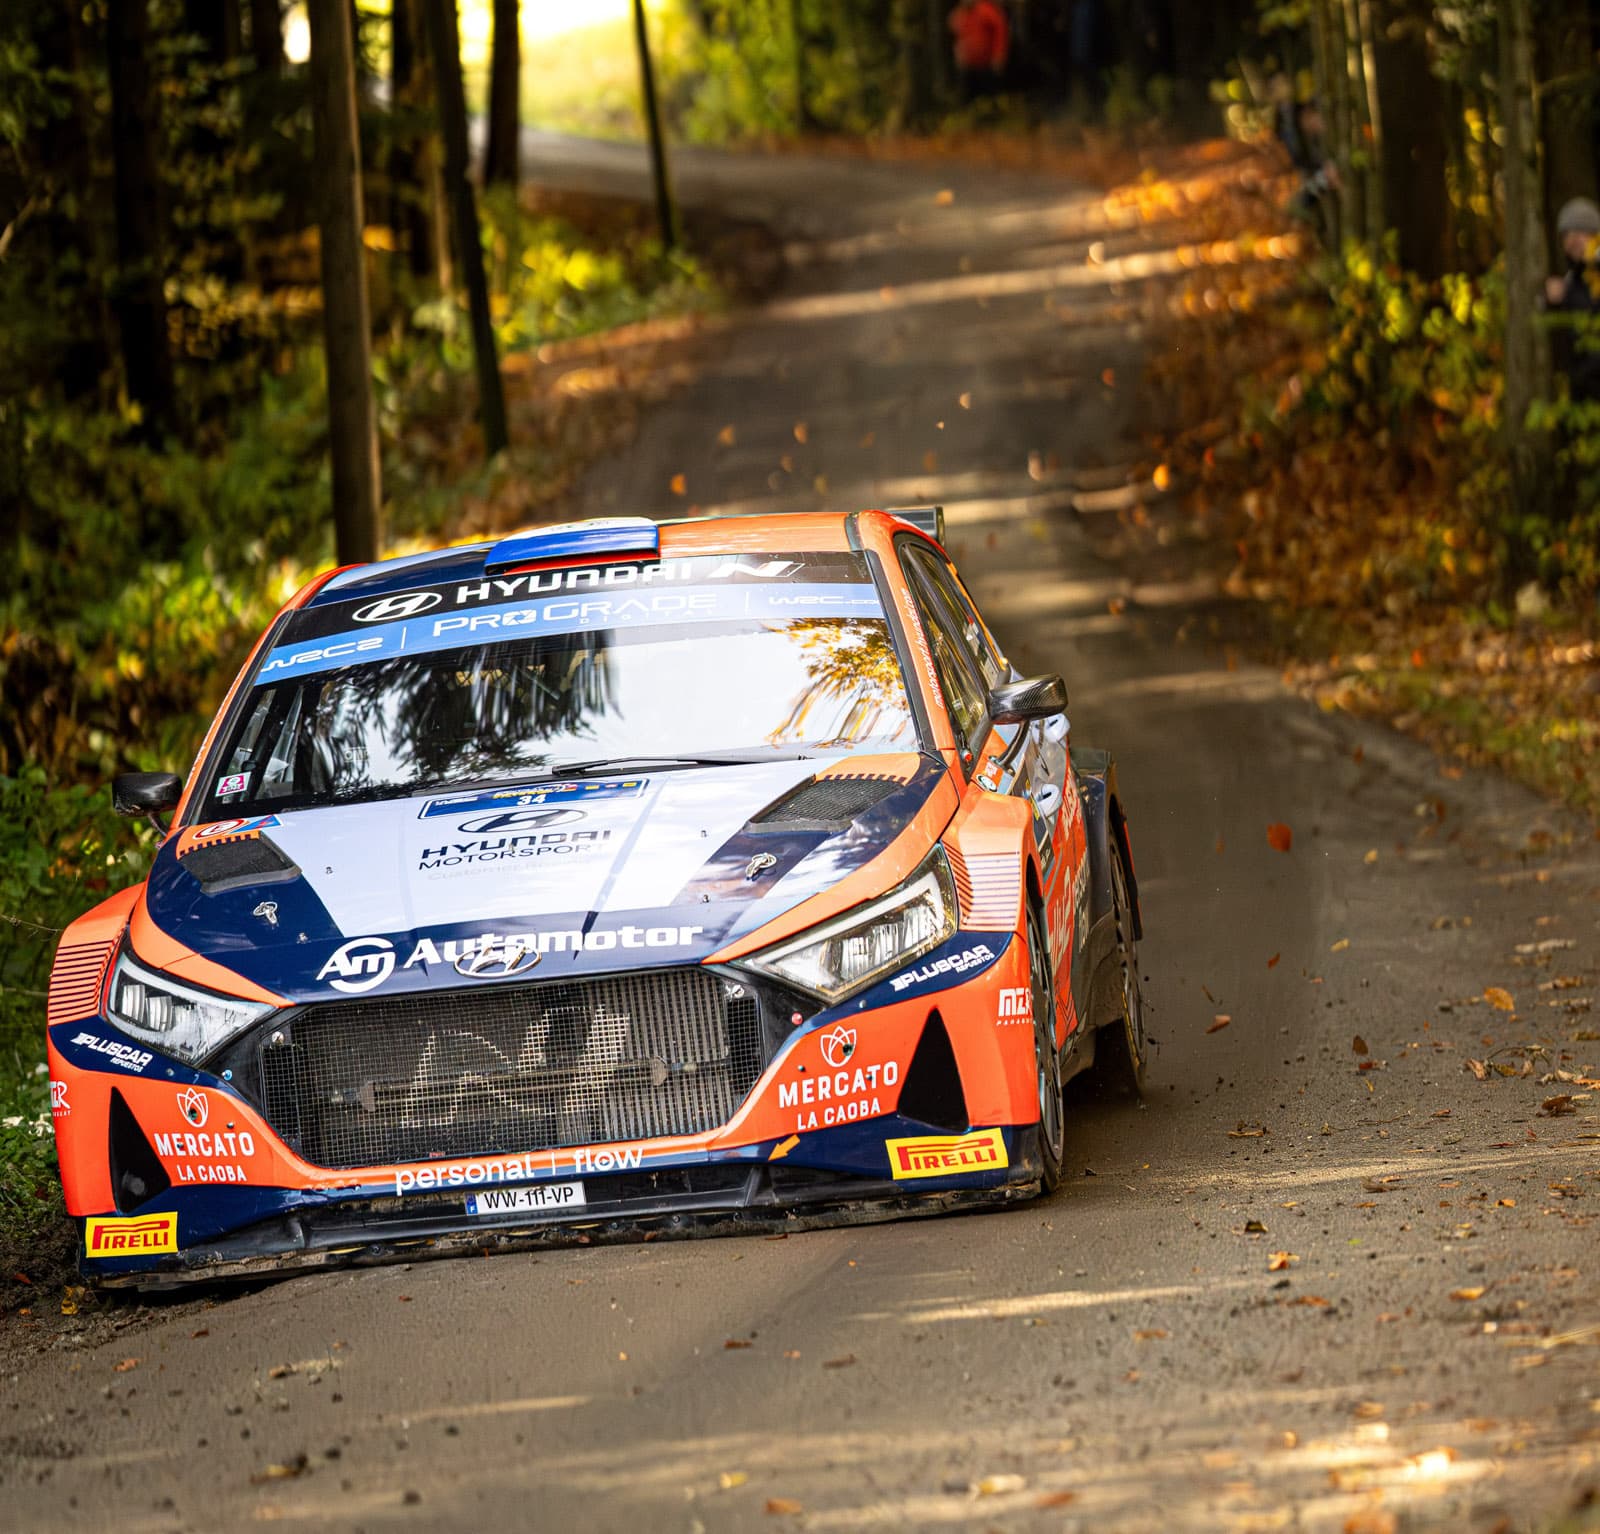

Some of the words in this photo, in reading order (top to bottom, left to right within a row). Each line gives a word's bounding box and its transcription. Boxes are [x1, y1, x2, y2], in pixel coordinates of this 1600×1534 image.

[456, 561, 692, 604] HYUNDAI
[517, 794, 546, 806] 34
[421, 830, 611, 859] HYUNDAI
[403, 925, 704, 969] Automotor
[70, 1032, 153, 1067] PLUSCAR
[779, 1061, 898, 1109] MERCATO
[797, 1112, 818, 1131] LA
[824, 1098, 881, 1124] CAOBA
[153, 1131, 255, 1158] MERCATO
[896, 1137, 997, 1172] PIRELLI
[176, 1165, 194, 1181] LA
[199, 1165, 248, 1182] CAOBA
[395, 1154, 534, 1196] personal
[573, 1147, 643, 1173] flow
[92, 1220, 170, 1250] PIRELLI
